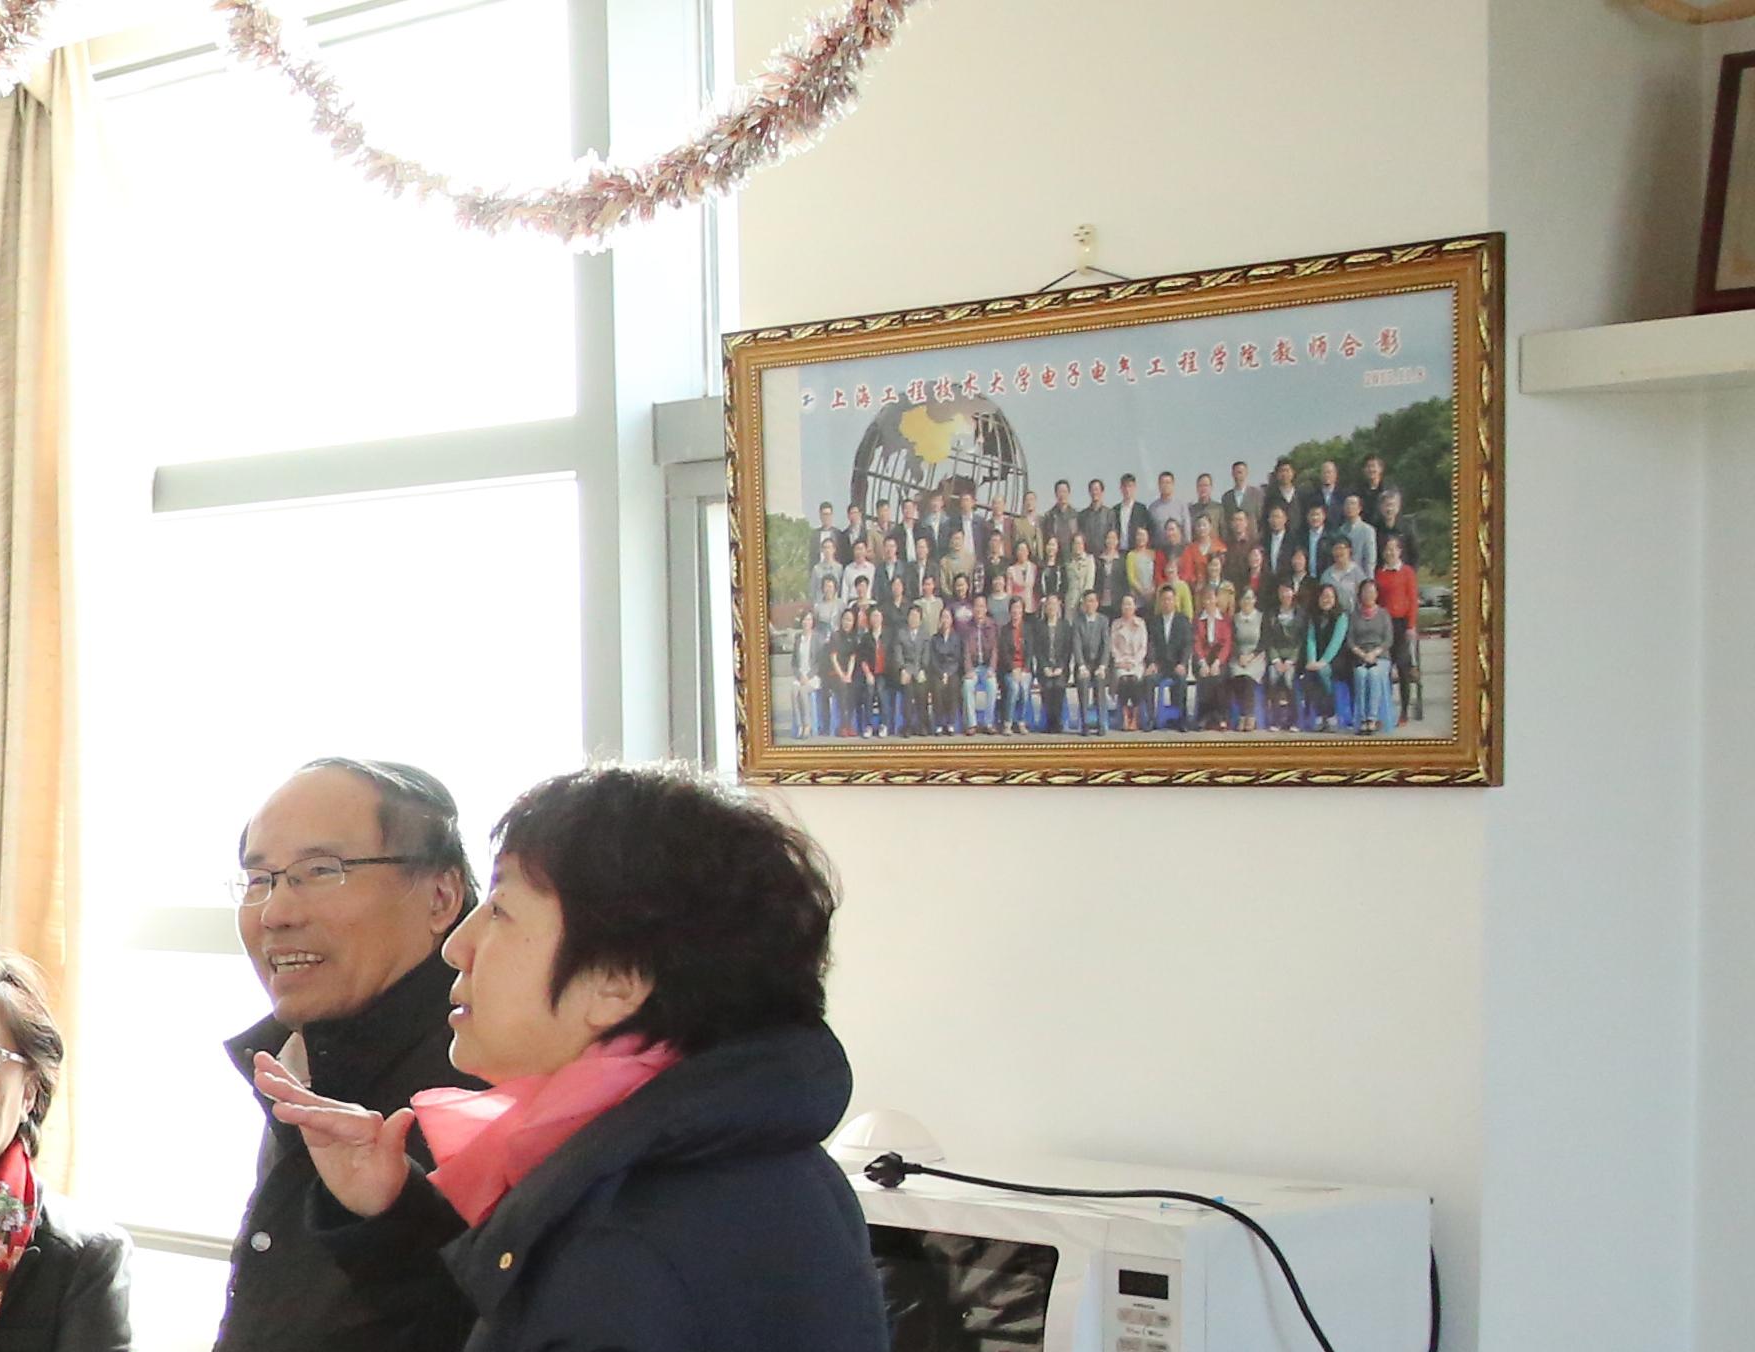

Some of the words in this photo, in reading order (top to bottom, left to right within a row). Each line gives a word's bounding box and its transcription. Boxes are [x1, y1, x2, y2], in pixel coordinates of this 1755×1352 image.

[831, 327, 1402, 409] 上海工程技术大学电子电气工程学院教师合影
